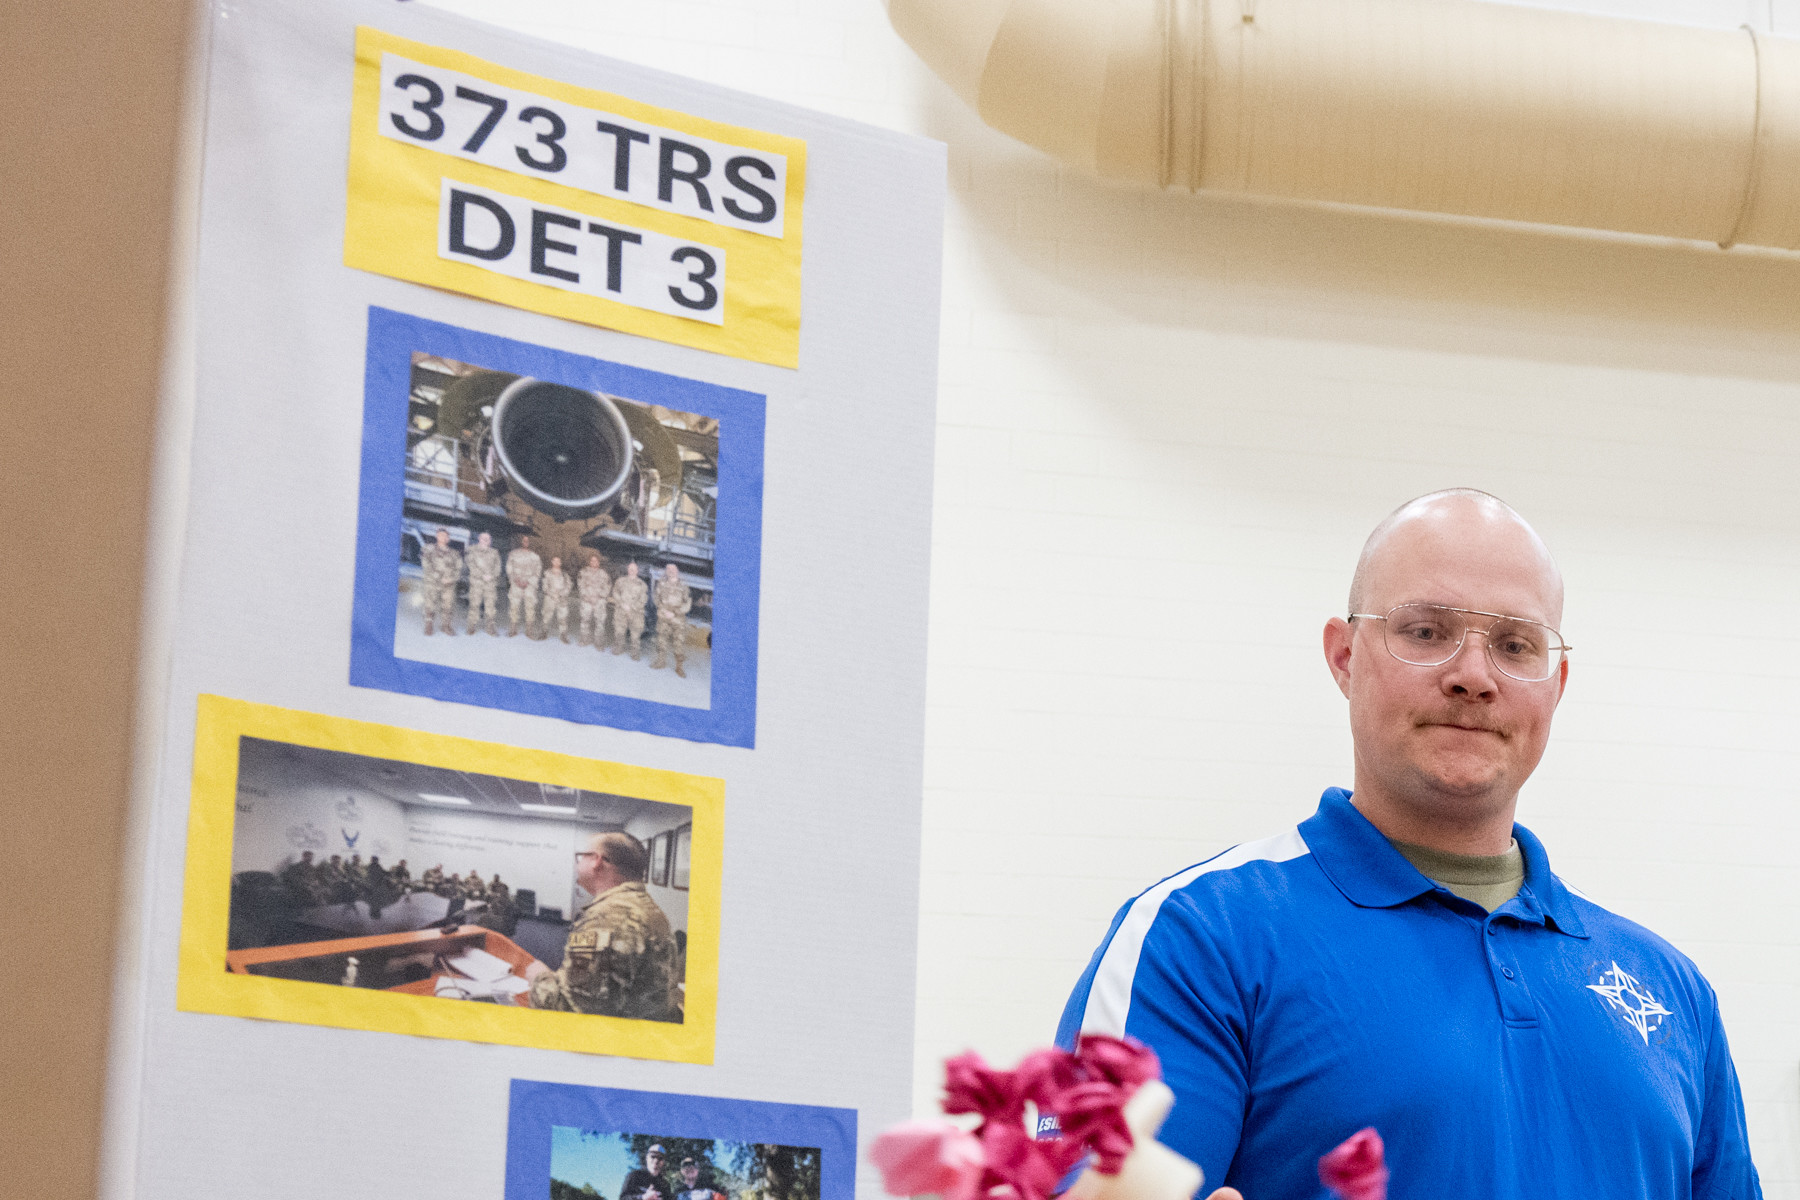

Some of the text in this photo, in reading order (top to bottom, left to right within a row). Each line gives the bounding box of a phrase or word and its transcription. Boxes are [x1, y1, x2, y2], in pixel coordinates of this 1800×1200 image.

[390, 74, 778, 223] 373 TRS
[448, 188, 719, 311] DET 3
